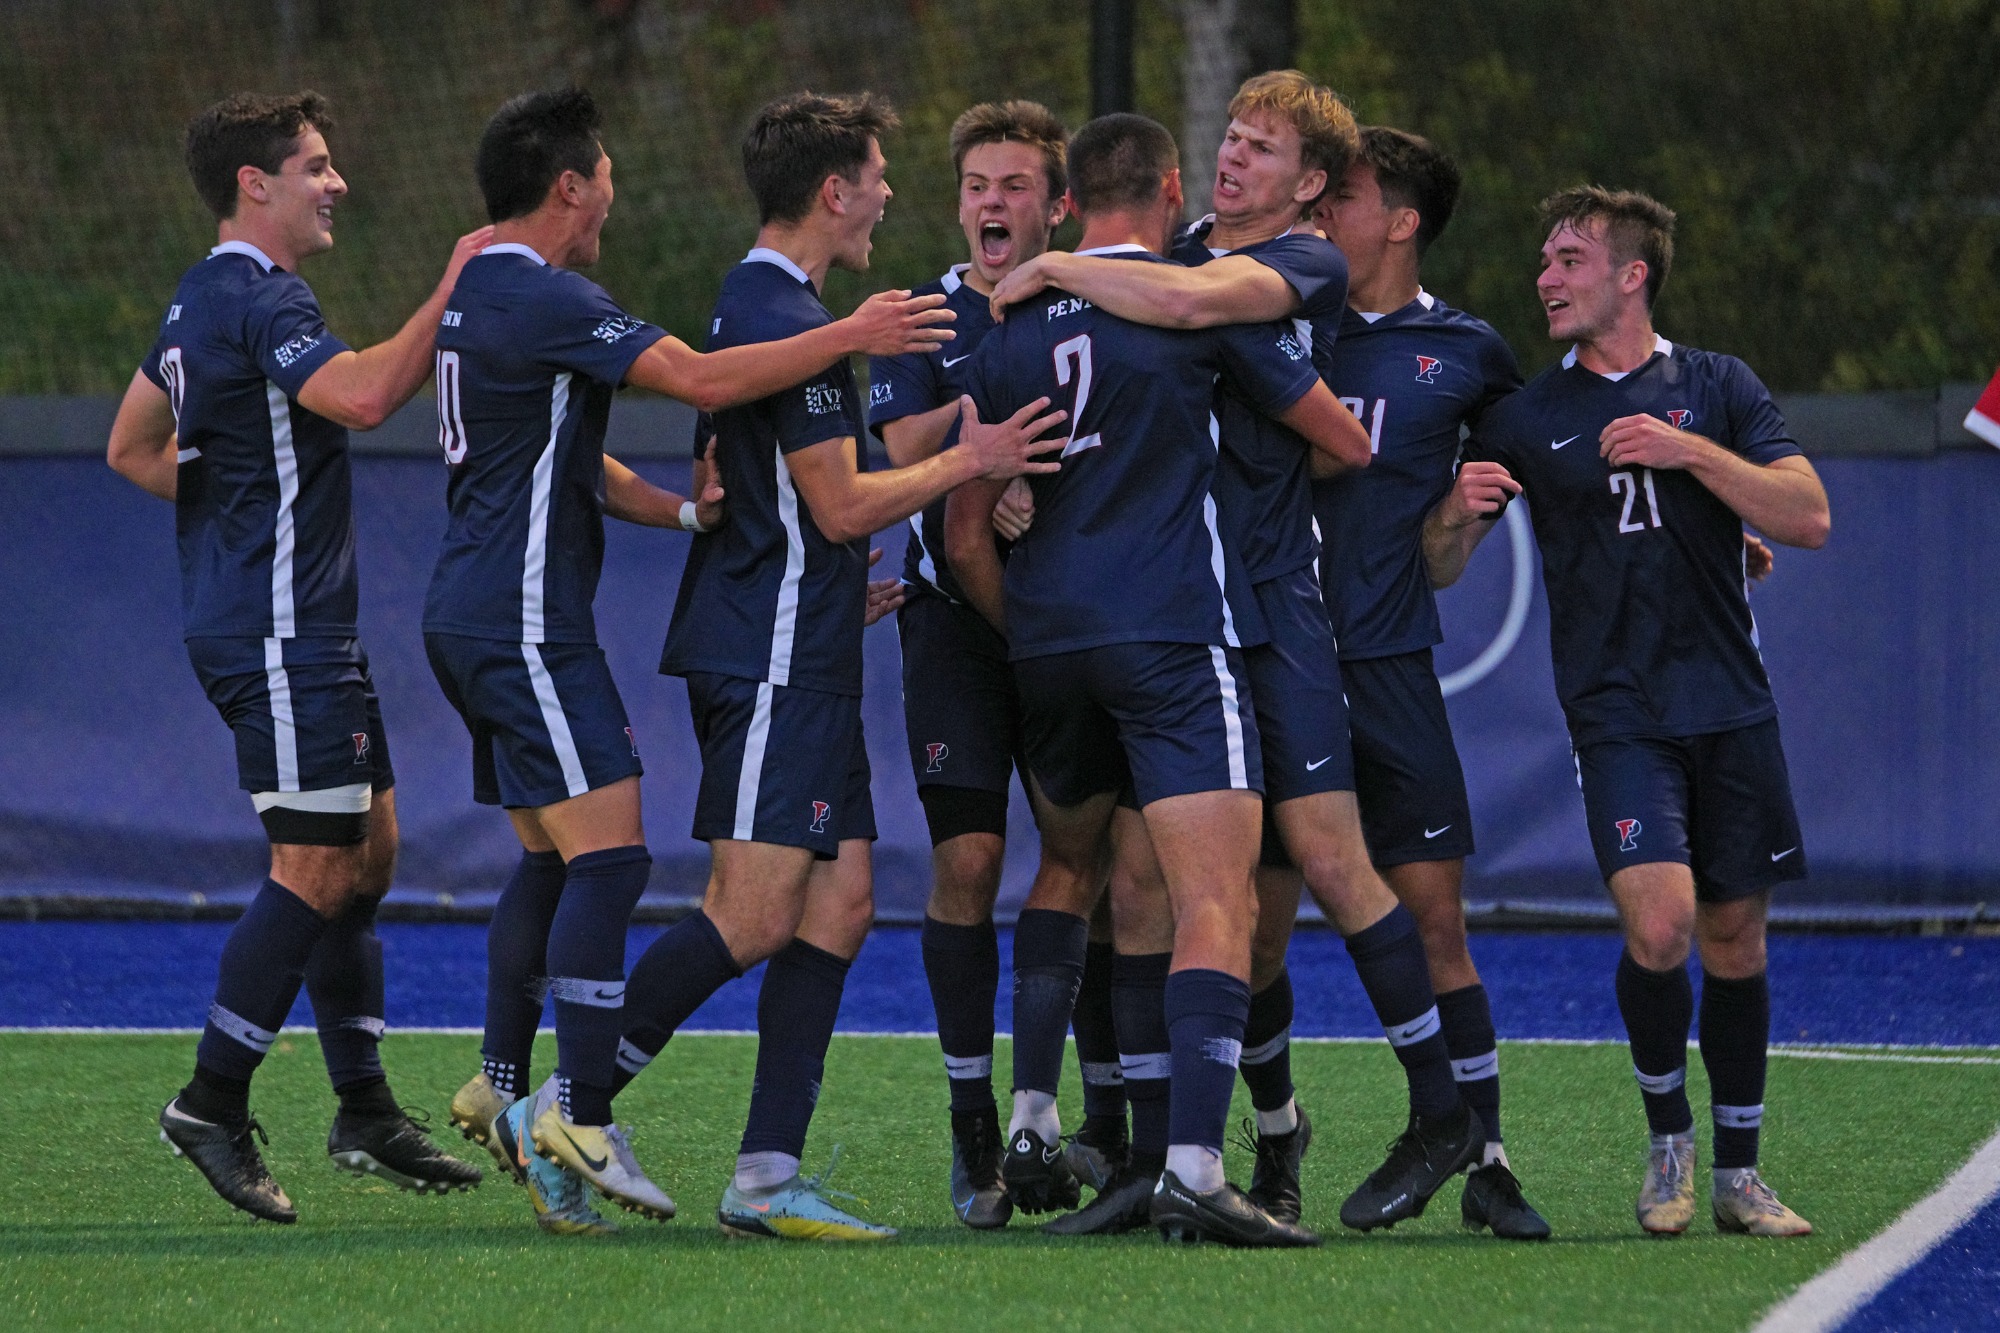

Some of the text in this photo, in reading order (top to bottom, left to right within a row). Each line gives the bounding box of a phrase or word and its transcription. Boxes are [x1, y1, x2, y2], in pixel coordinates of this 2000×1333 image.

[816, 388, 842, 407] IVY
[1052, 333, 1102, 460] 2
[1609, 468, 1663, 534] 21
